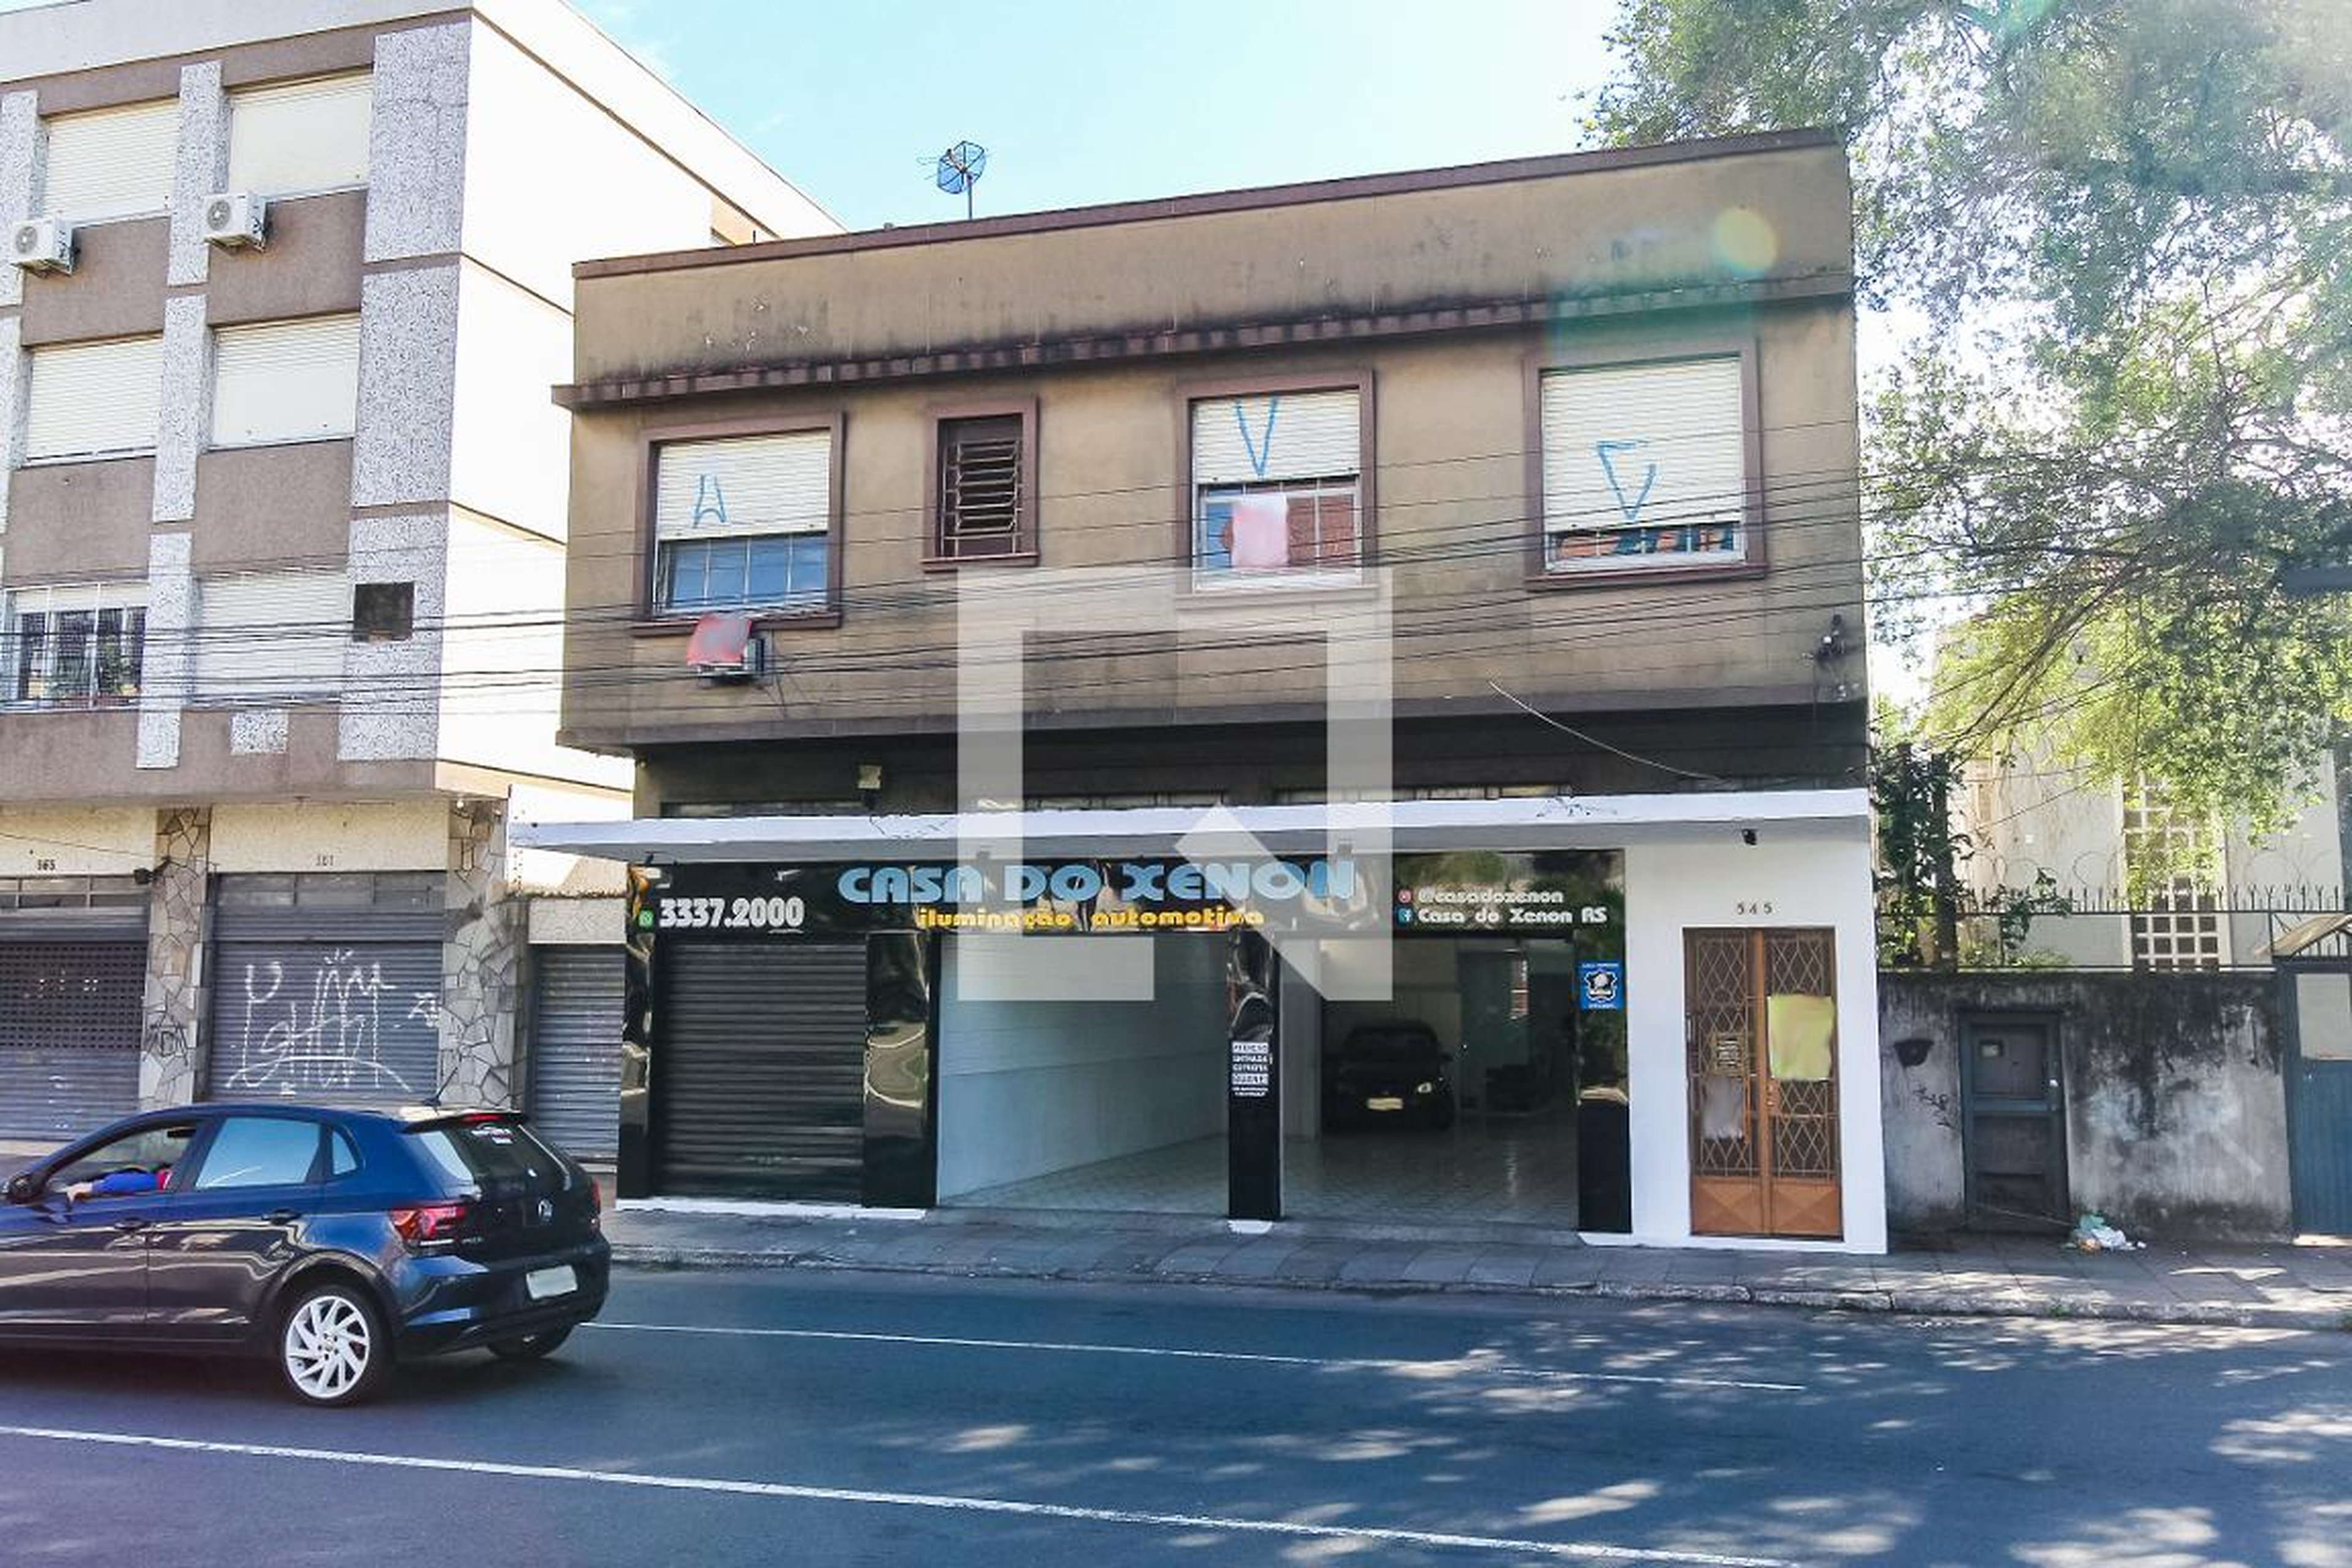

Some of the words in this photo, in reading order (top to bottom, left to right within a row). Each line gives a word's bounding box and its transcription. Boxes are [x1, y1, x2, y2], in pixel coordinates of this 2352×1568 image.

[838, 865, 983, 904] CASA
[1005, 865, 1101, 902] DO
[1121, 861, 1355, 900] XENON
[659, 897, 805, 927] 3337.2000
[1418, 907, 1465, 923] Casa
[1474, 907, 1499, 923] do
[1581, 907, 1607, 924] RS
